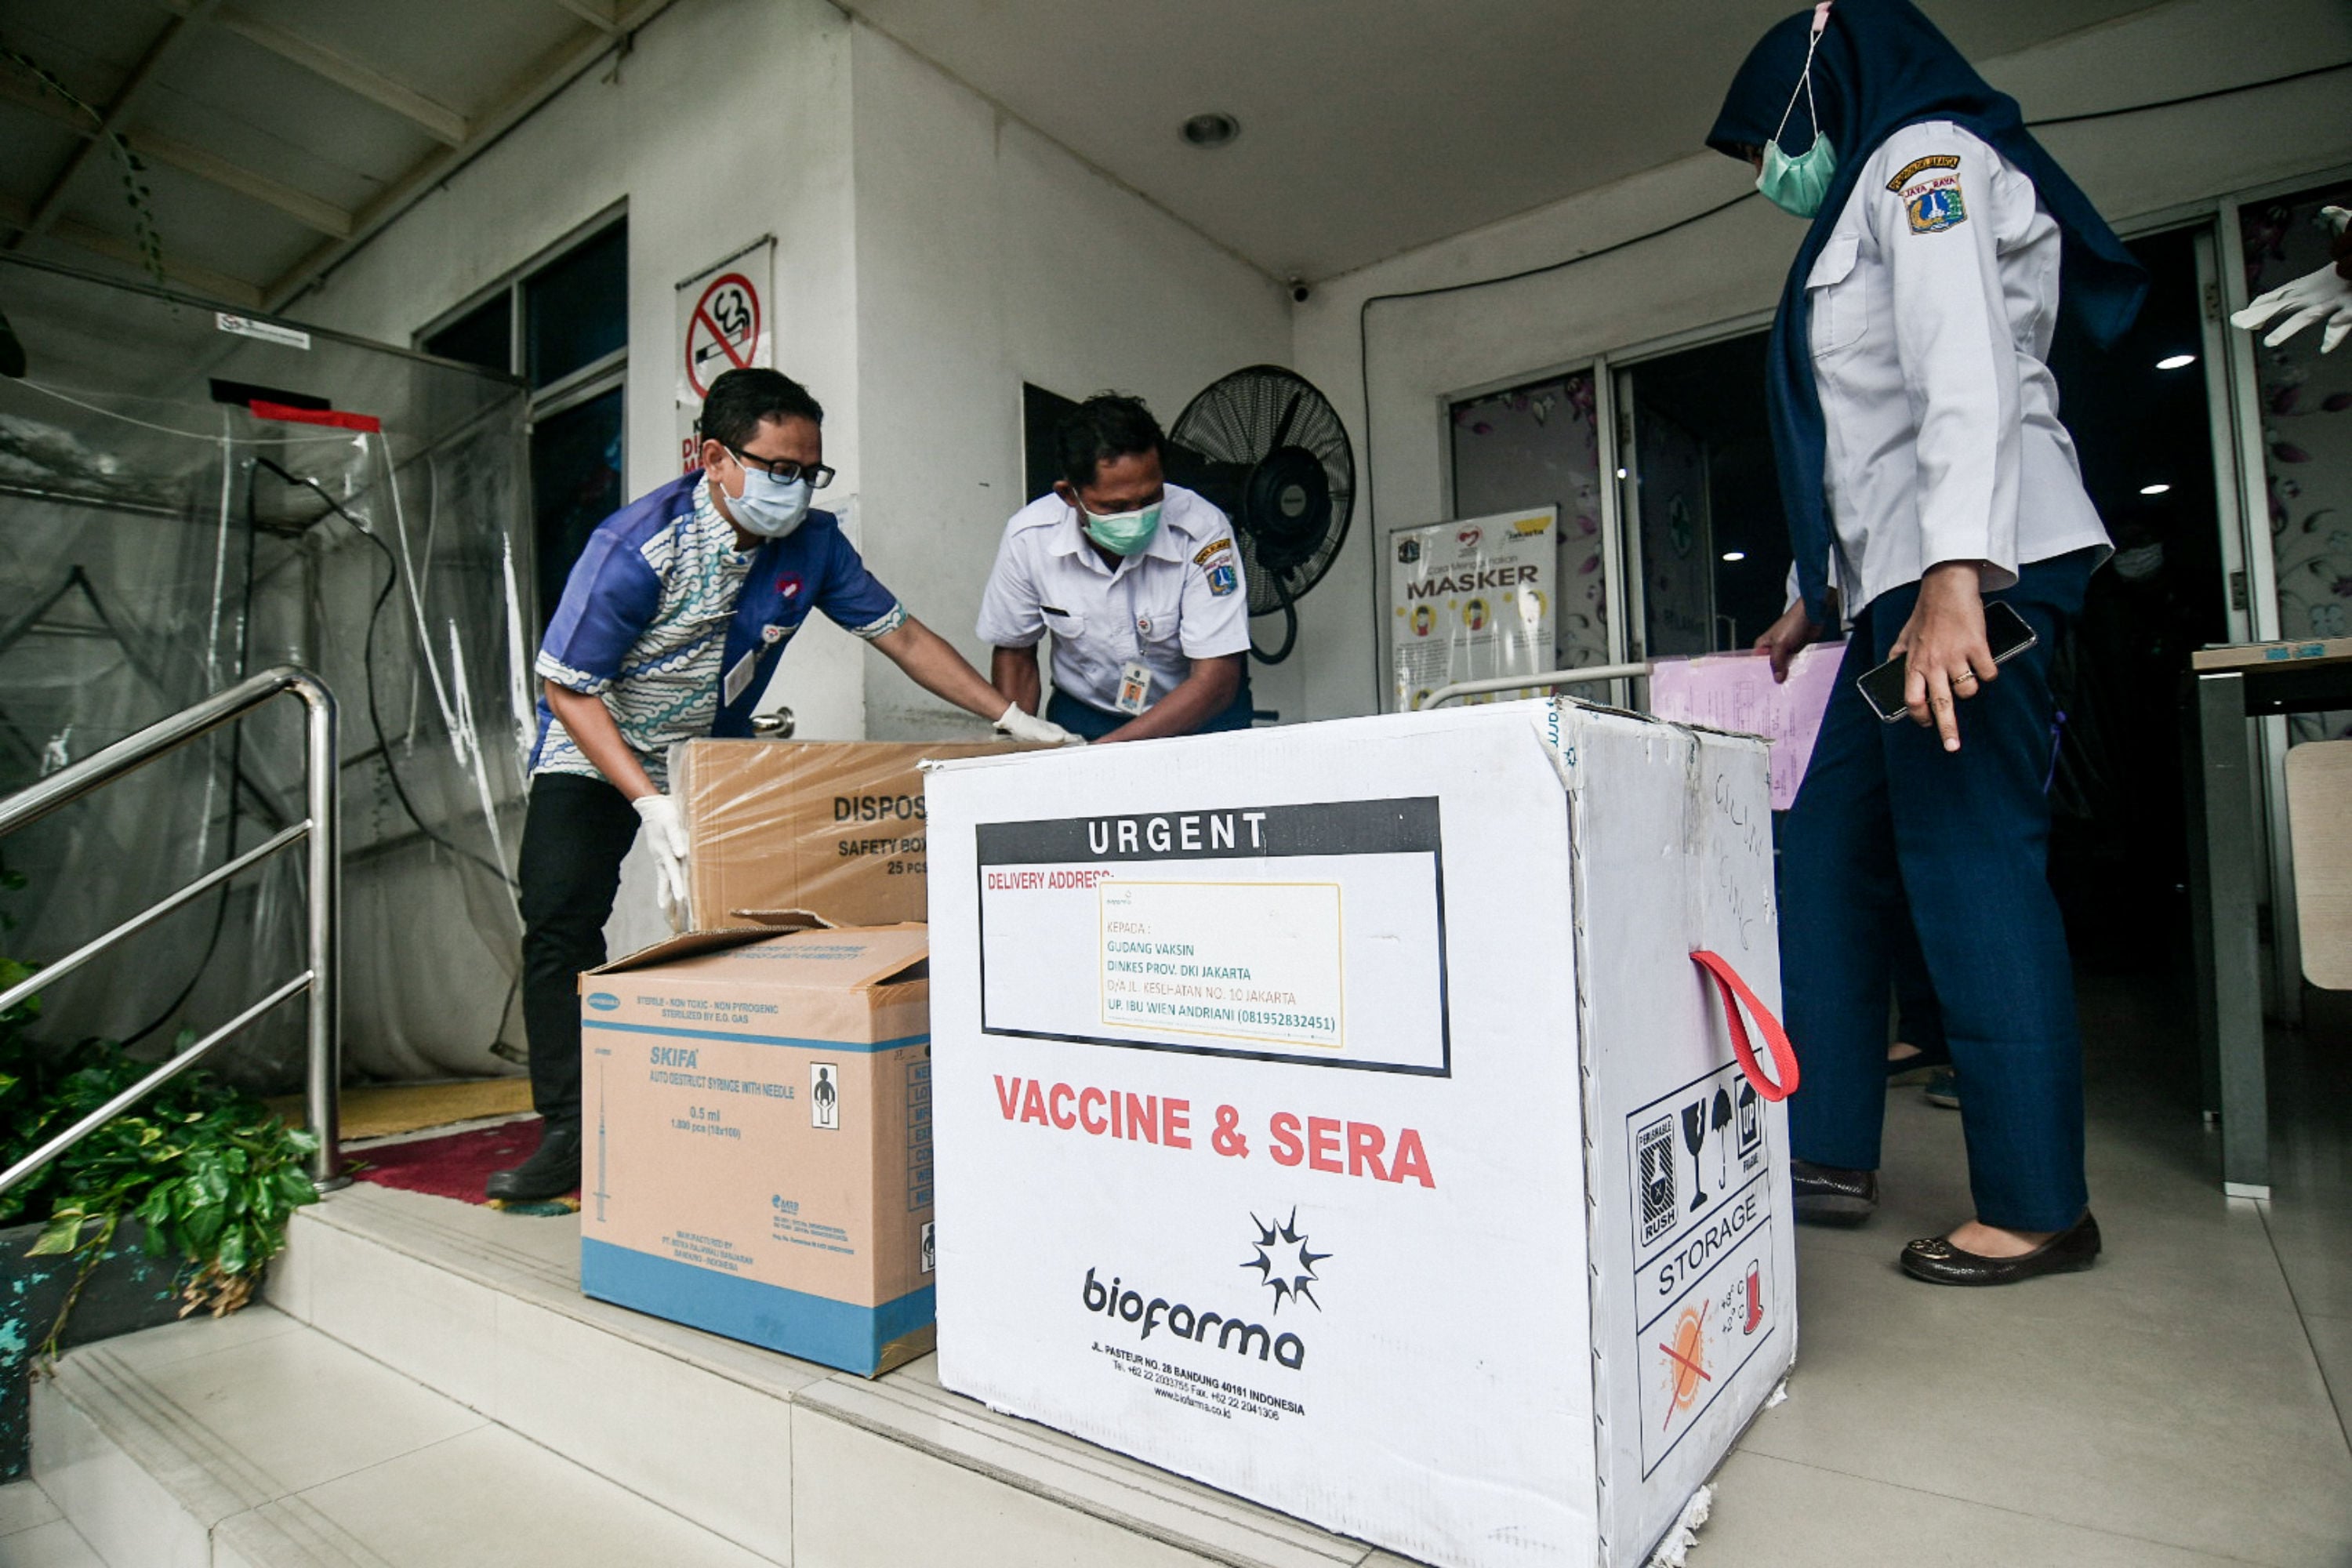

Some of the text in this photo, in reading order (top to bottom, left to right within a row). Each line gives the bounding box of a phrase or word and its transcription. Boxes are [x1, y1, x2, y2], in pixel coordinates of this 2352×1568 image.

[1407, 564, 1539, 600] MASKER
[1088, 812, 1266, 855] URGENT
[838, 838, 898, 856] SAFETY
[887, 861, 903, 875] 25
[988, 872, 1045, 890] DELIVERY
[1107, 921, 1145, 934] KEPADA
[1107, 940, 1194, 956] GUDANG VAKSIN
[1107, 960, 1251, 980] DINKES PROV. DKI JAKARTA
[637, 995, 665, 1007] STERILE
[670, 998, 685, 1007] NON
[688, 999, 708, 1010] TOXIC
[714, 1001, 731, 1011] NON
[733, 1003, 779, 1014] PYROGENIC
[1206, 985, 1226, 1000] NO.
[1229, 987, 1243, 1002] 10
[1246, 989, 1297, 1006] JAKARTA
[731, 1014, 749, 1024] GAS
[1108, 998, 1123, 1011] UP.
[1126, 1000, 1143, 1013] IBU
[1146, 1002, 1175, 1016] WIEN
[1178, 1004, 1235, 1021] ANDRIANI
[650, 1046, 698, 1069] SKIFA
[650, 1069, 795, 1100] AUTO DESTRUCT SYRINGE WITH NEEDLE
[690, 1106, 720, 1122] 0.5 ml
[1742, 1102, 1755, 1135] UP
[993, 1074, 1192, 1150] VACCINE
[1211, 1104, 1250, 1160] &
[1269, 1111, 1437, 1189] SERA
[1646, 1208, 1675, 1240] RUSH
[1659, 1193, 1757, 1296] STORAGE
[1083, 1266, 1305, 1370] biofarma
[1105, 1345, 1144, 1366] PASTEUR
[1145, 1357, 1160, 1371] NO.
[1174, 1366, 1219, 1389] BANDUNG
[1250, 1388, 1305, 1417] INDONESIA
[1154, 1387, 1232, 1420] www.biofarma.co.id
[1228, 1396, 1240, 1409] 22
